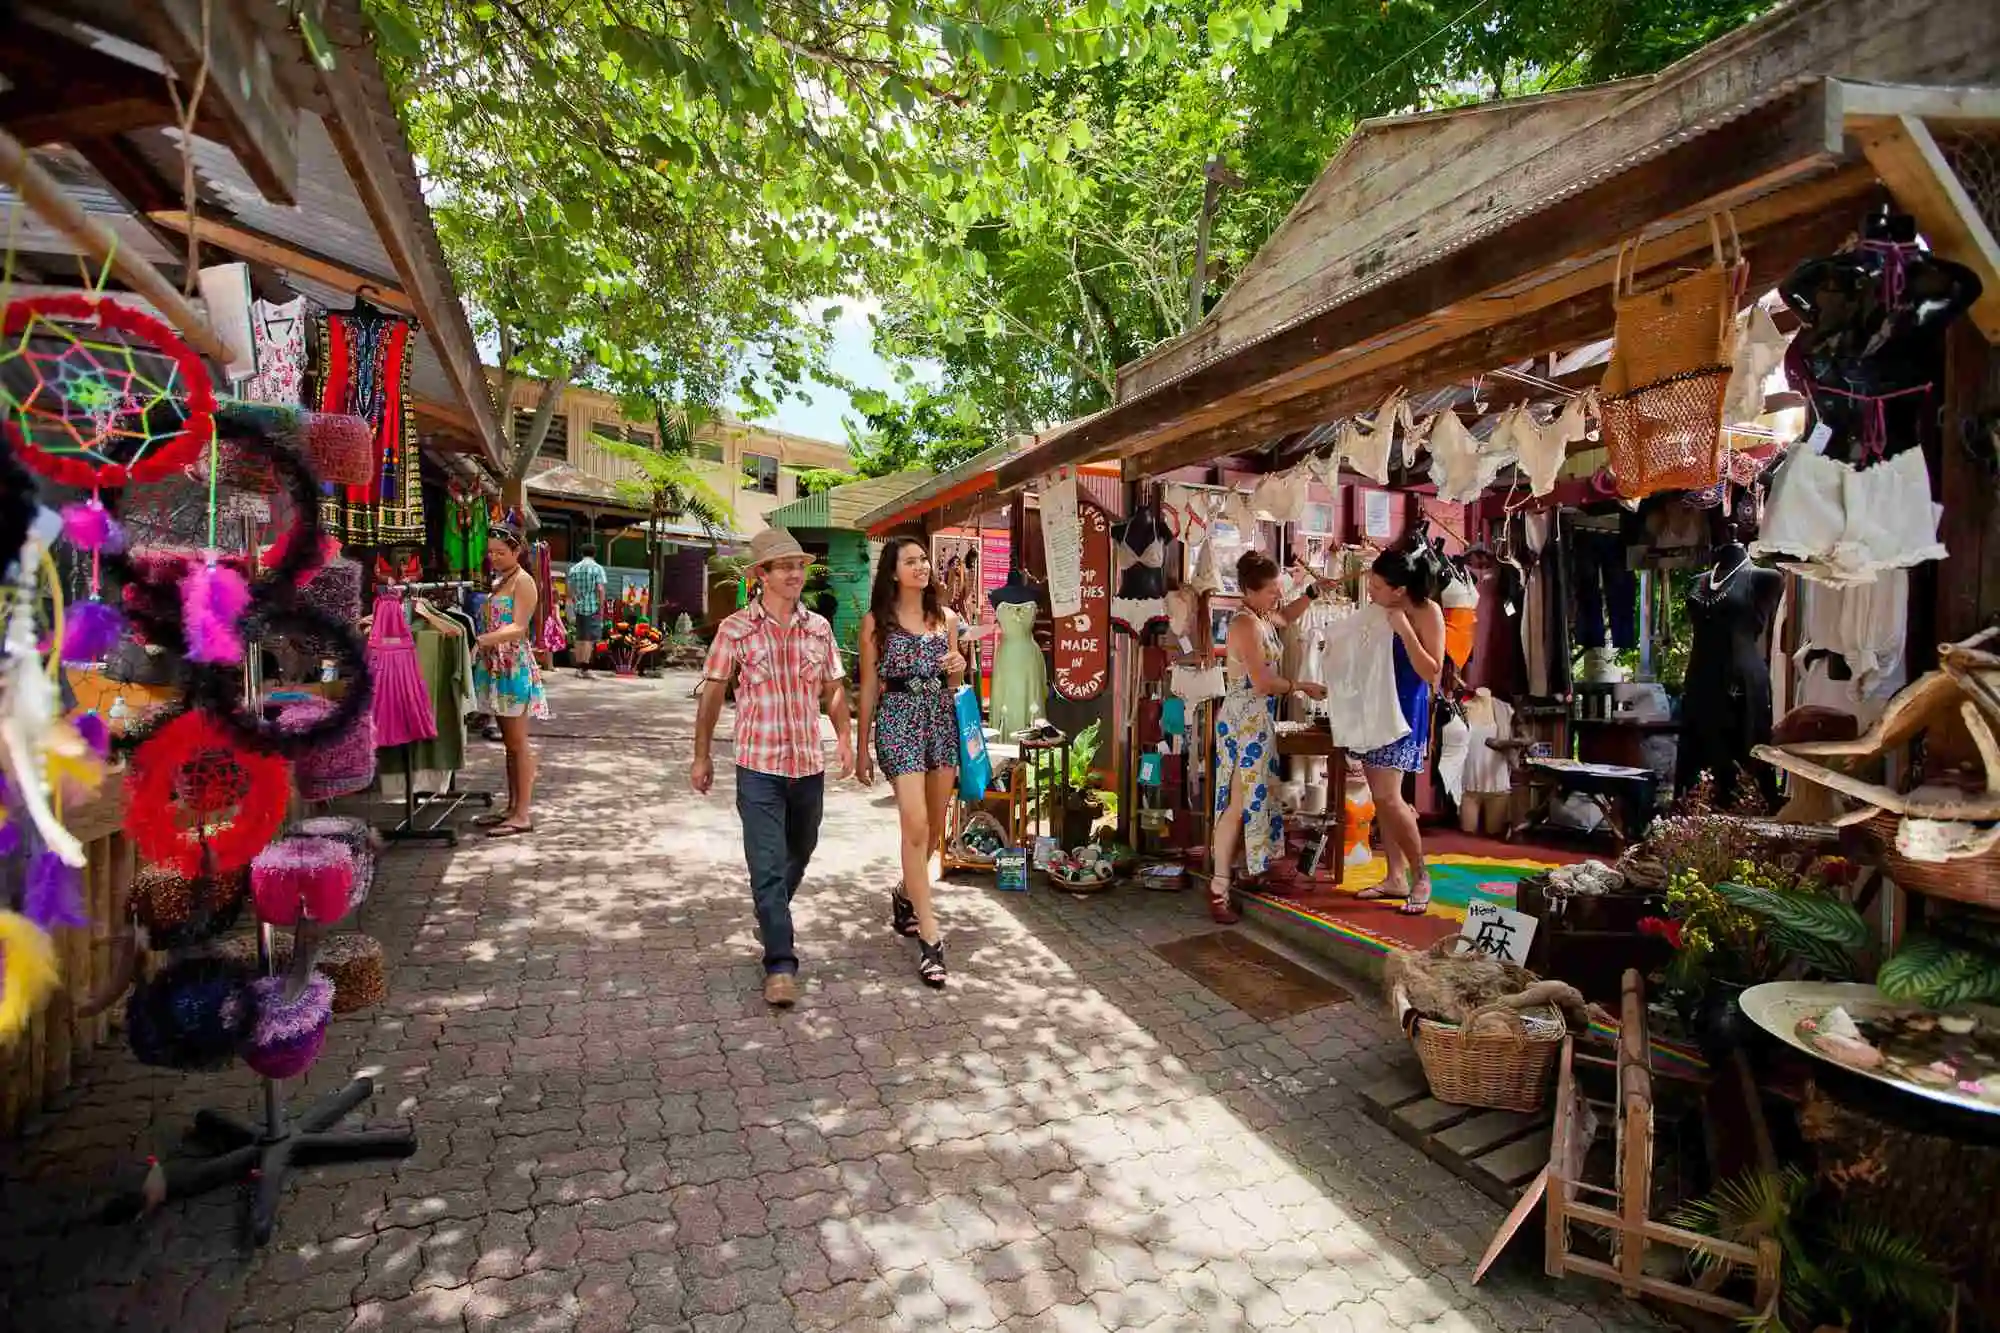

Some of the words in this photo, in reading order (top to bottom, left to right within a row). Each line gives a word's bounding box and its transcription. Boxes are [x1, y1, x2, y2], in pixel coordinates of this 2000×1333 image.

[1060, 638, 1100, 652] MADE
[1071, 656, 1084, 668] IN
[1056, 668, 1105, 697] KURANDA
